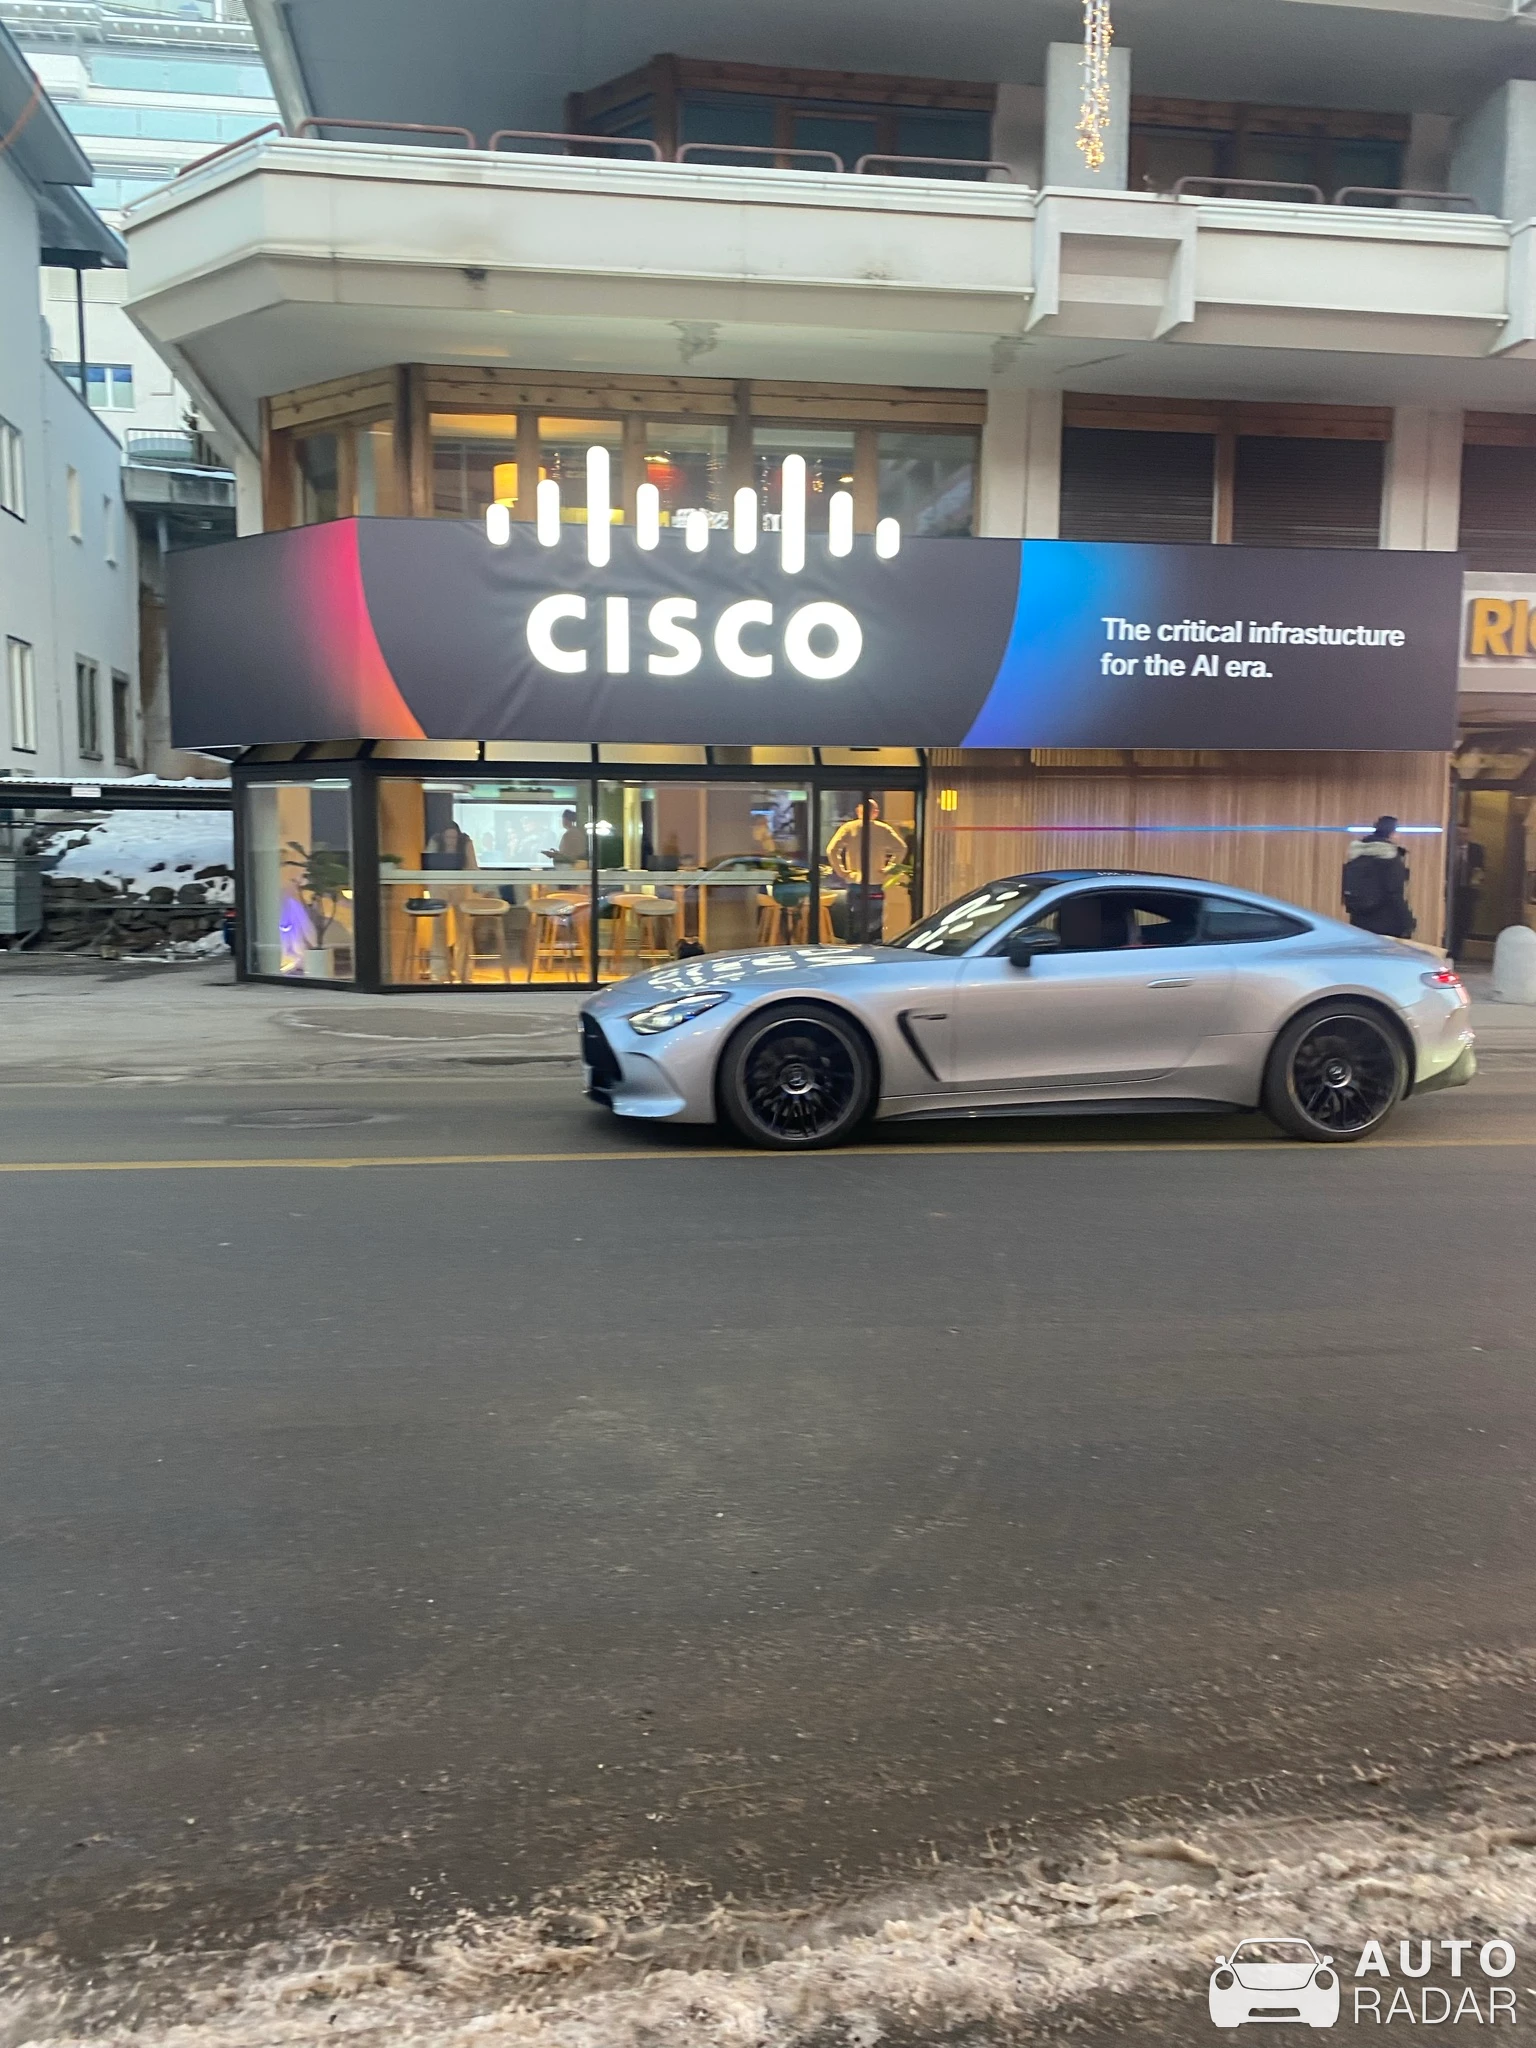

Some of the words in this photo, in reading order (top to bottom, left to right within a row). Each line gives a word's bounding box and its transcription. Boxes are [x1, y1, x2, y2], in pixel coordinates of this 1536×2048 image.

[526, 594, 863, 680] CISCO
[1101, 617, 1151, 641] The
[1157, 619, 1242, 643] critical
[1248, 621, 1406, 647] infrastucture
[1100, 652, 1139, 676] for
[1143, 653, 1186, 677] the
[1190, 654, 1219, 677] AI
[1225, 659, 1273, 678] era.
